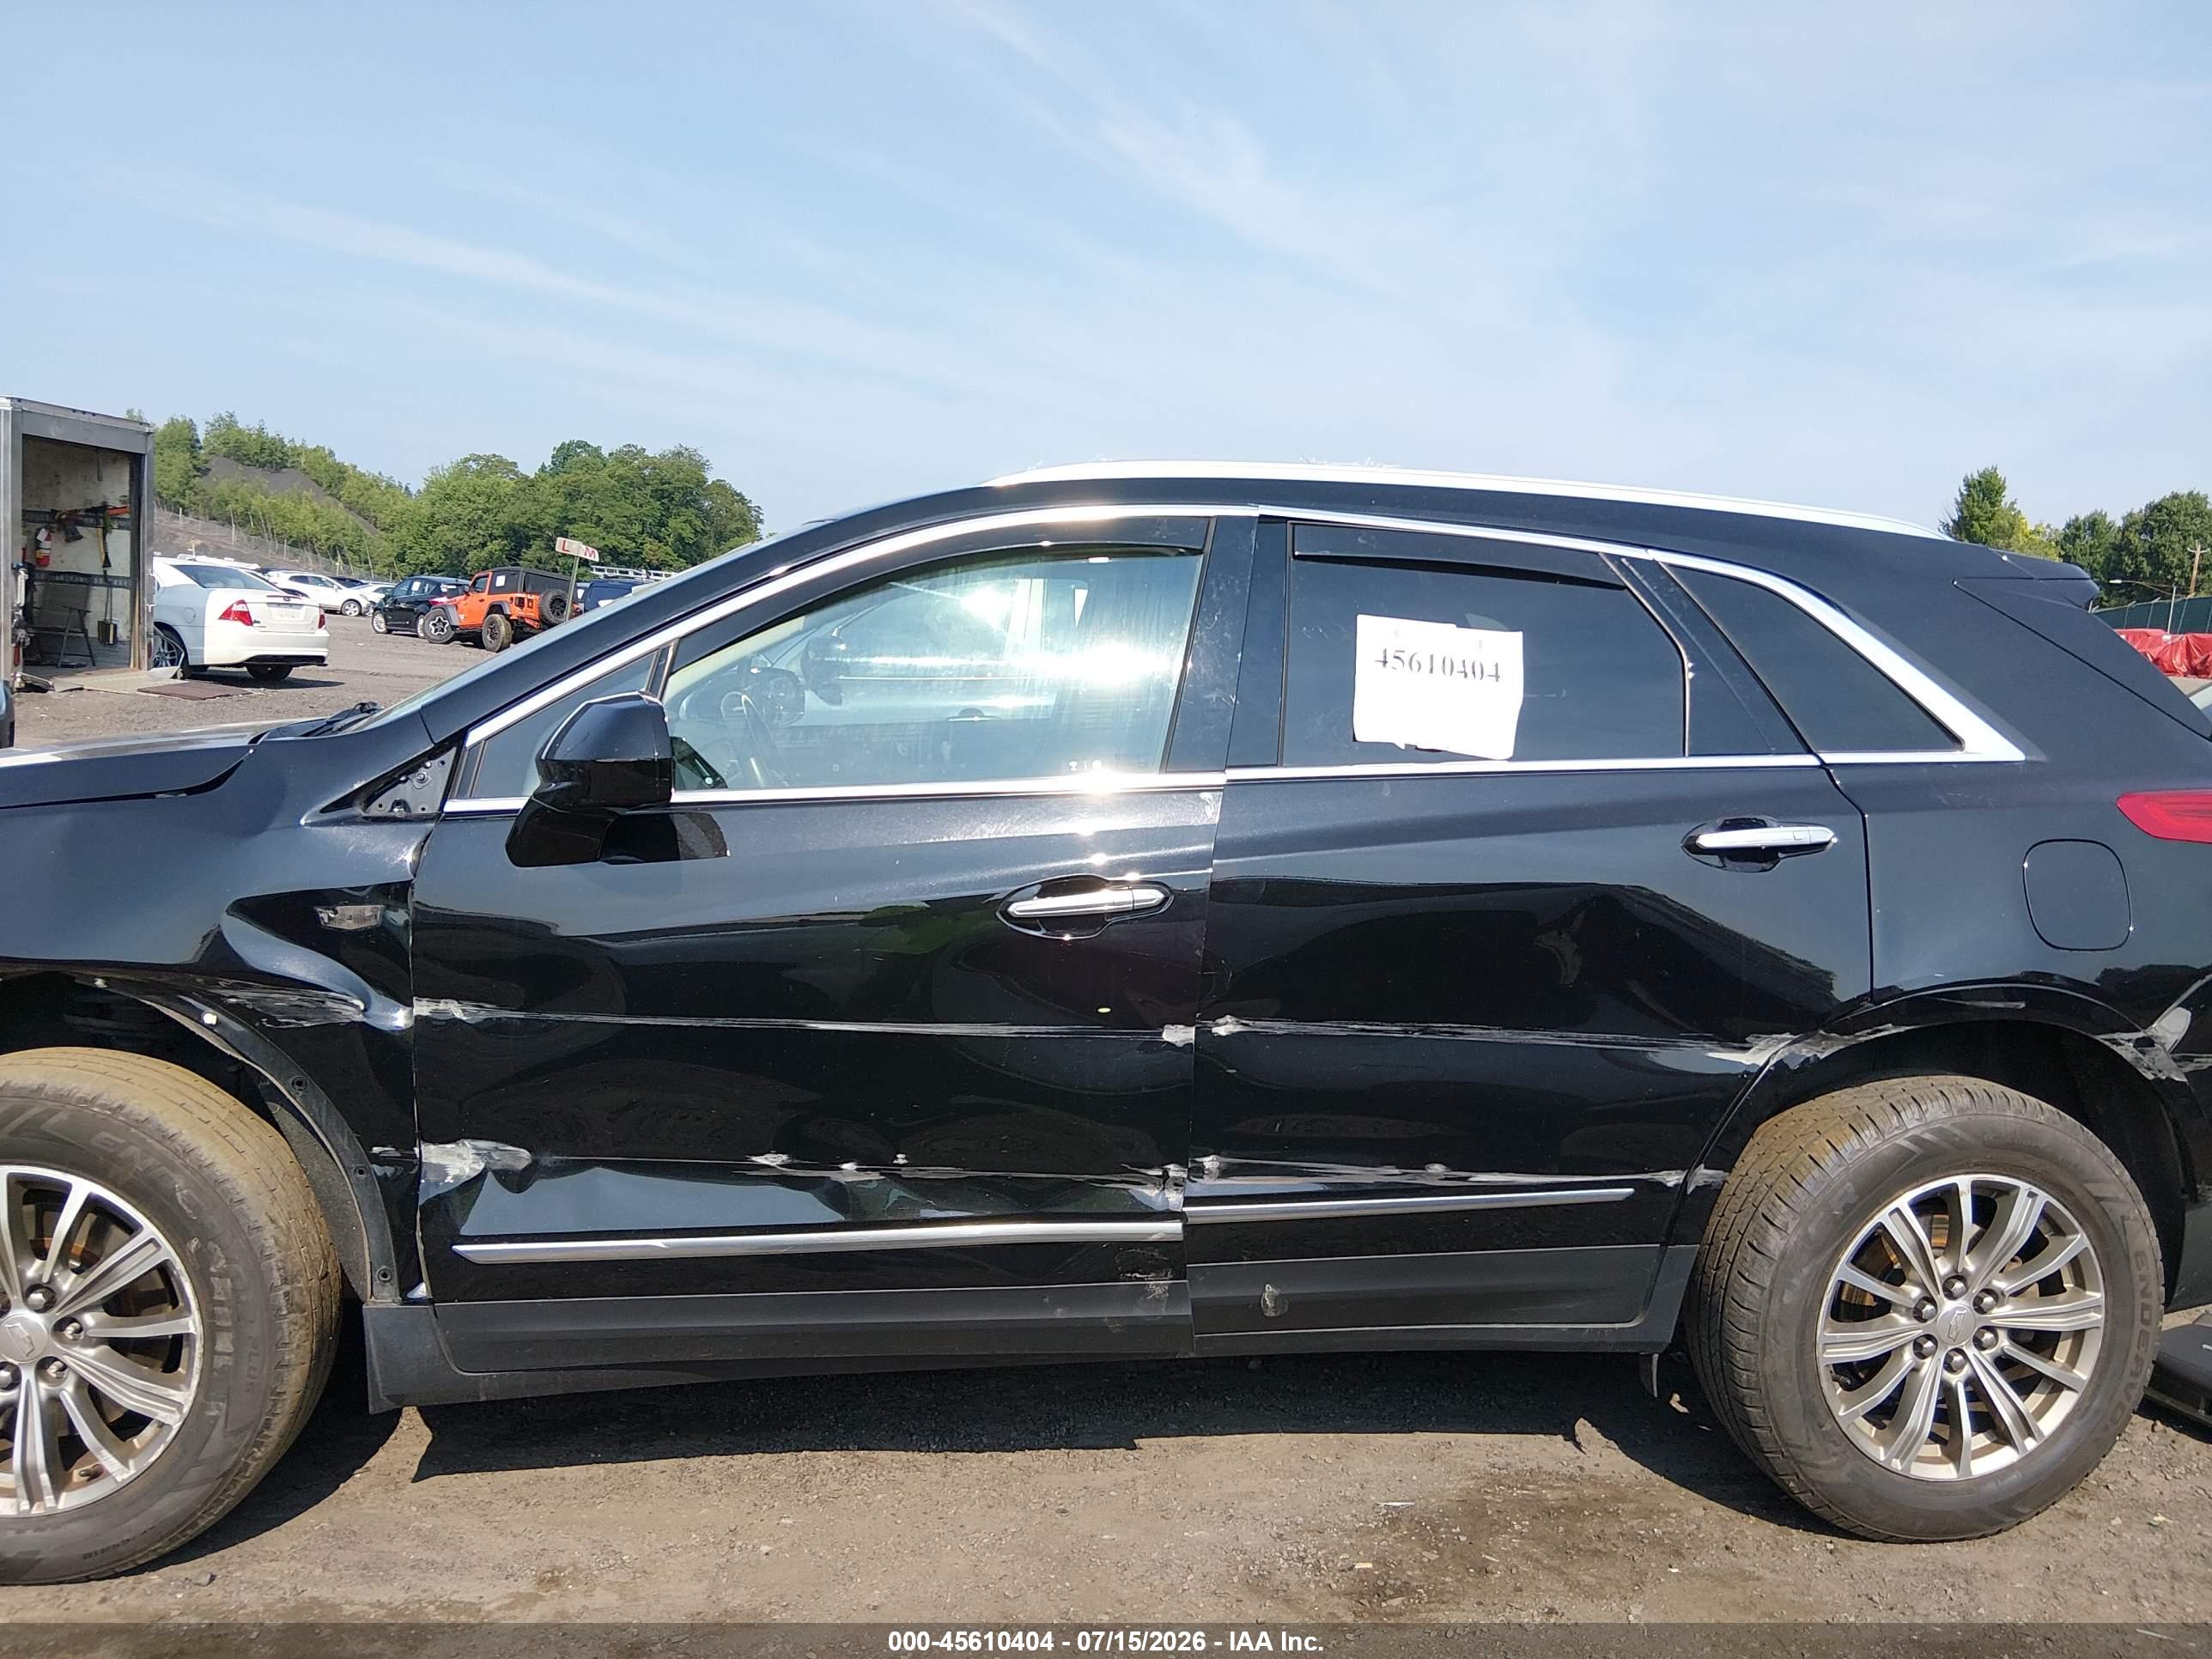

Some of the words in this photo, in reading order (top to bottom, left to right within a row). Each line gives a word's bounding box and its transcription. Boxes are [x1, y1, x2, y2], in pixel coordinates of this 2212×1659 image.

[562, 539, 570, 552] L
[584, 547, 596, 559] M
[1374, 647, 1502, 684] 45610404
